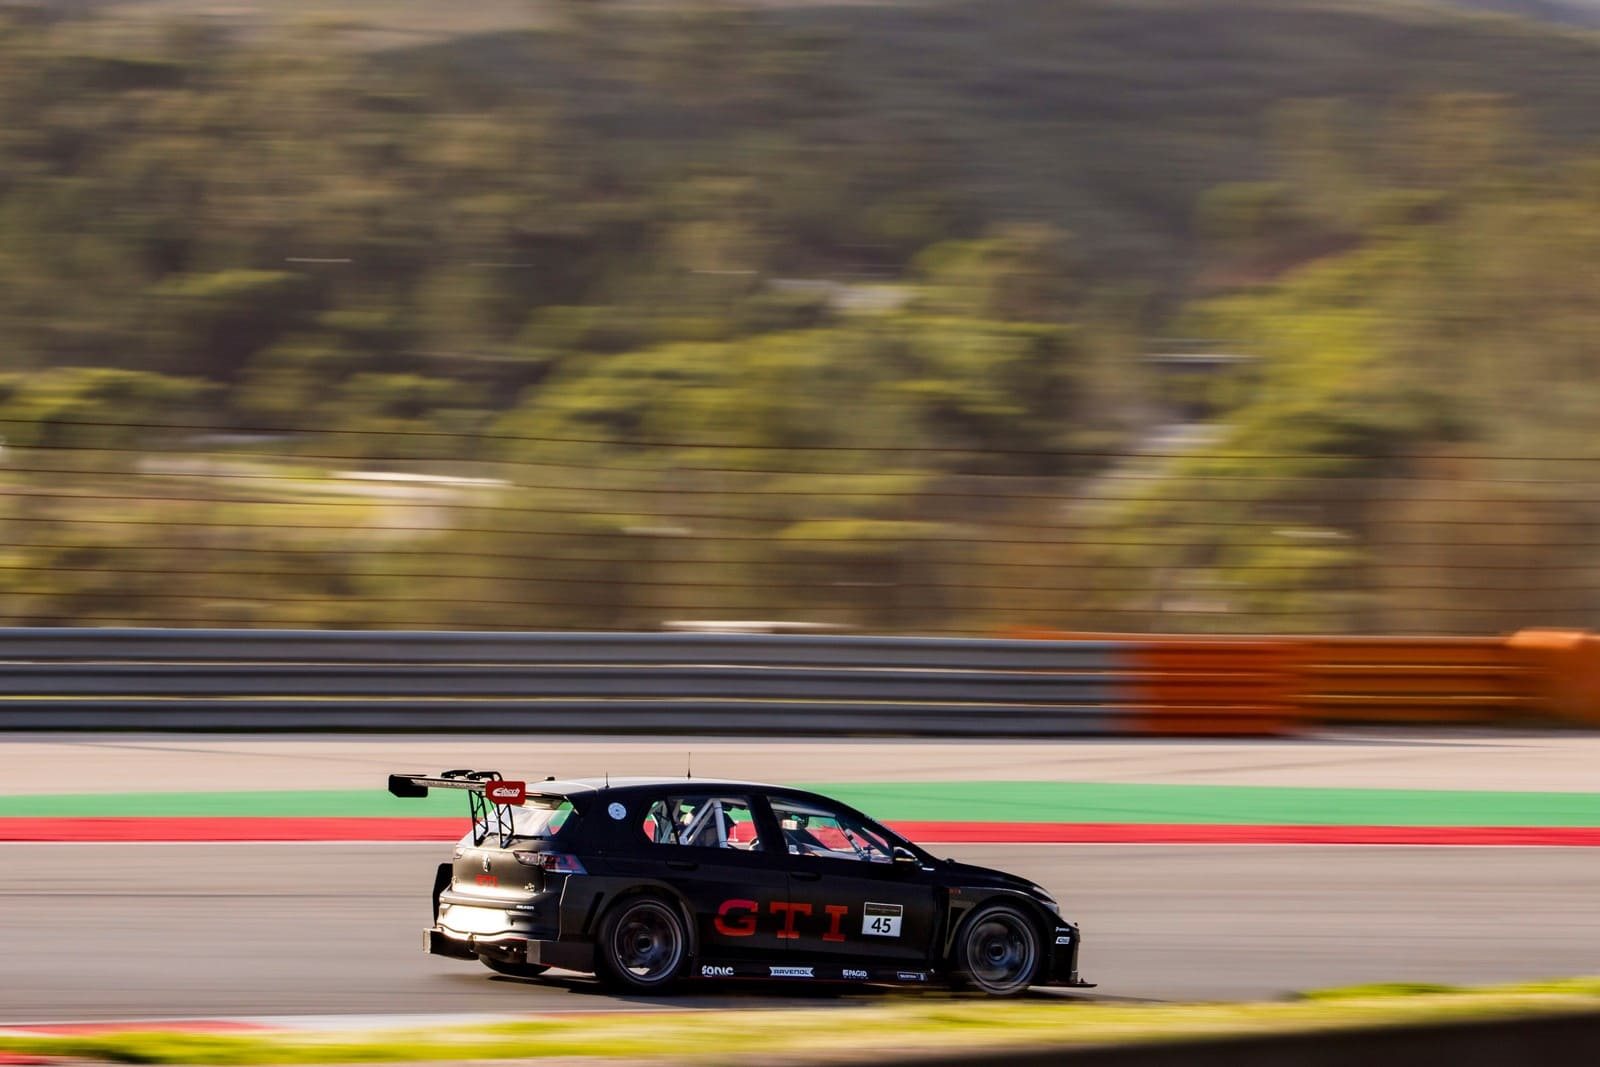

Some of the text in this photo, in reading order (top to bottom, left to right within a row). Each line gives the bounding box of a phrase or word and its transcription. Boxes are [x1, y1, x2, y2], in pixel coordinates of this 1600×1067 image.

[714, 899, 848, 942] GTI
[871, 917, 892, 934] 45
[774, 968, 809, 976] RAVENOL
